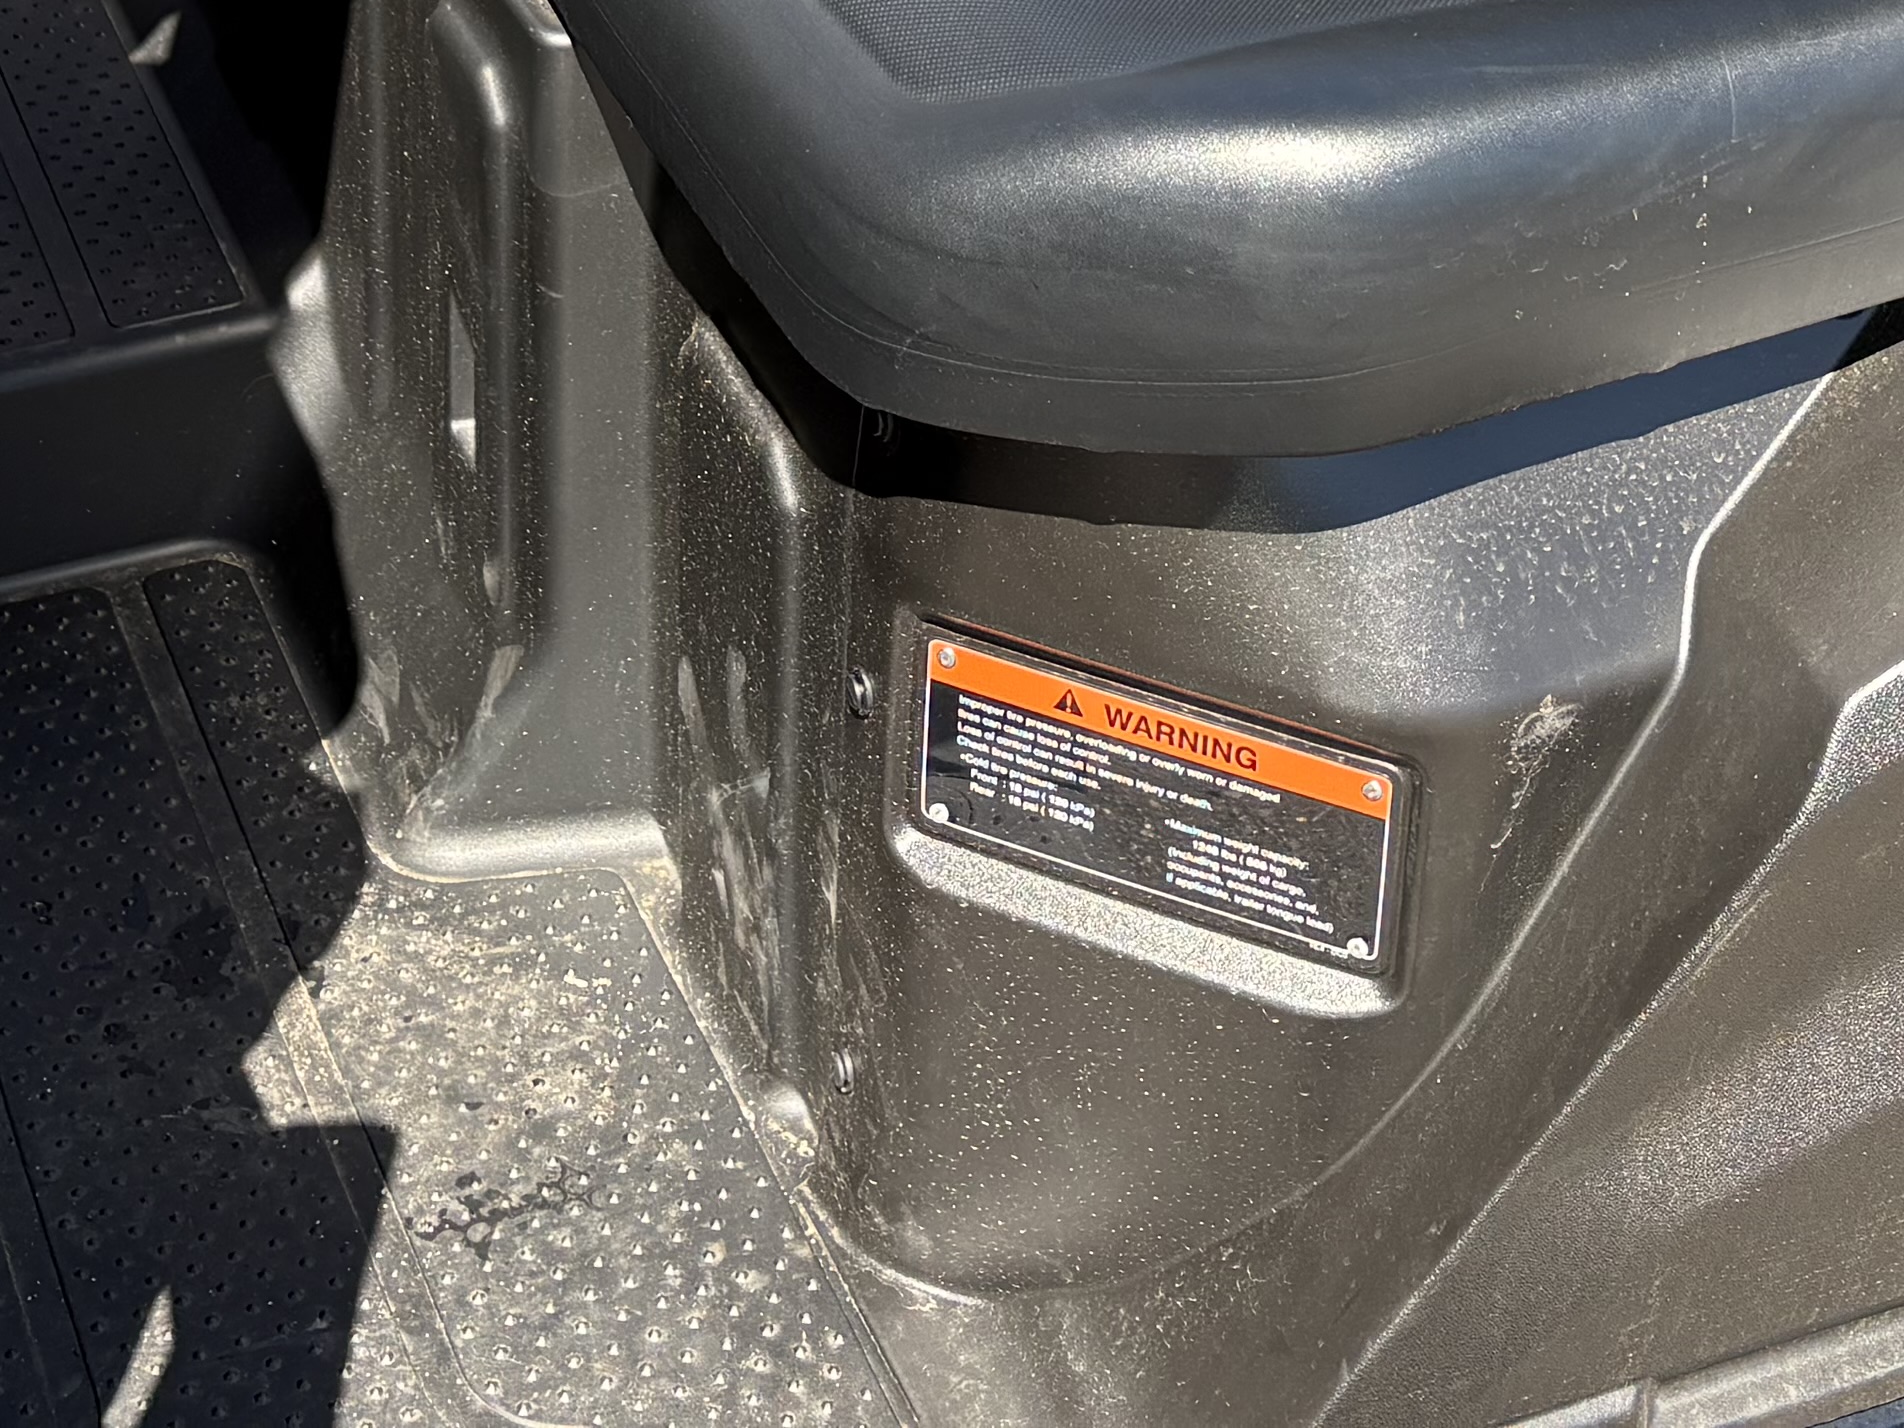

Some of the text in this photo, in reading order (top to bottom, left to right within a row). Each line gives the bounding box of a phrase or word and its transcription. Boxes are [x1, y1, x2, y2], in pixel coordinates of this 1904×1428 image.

[956, 733, 1101, 790] Check tires before each use.
[957, 707, 1112, 766] tires can cause loss of control.
[958, 693, 1281, 807] Improper tire pressure, overloading or overly worn or damaged
[1103, 702, 1259, 774] WARNING
[957, 720, 1213, 812] Loss of control can result in severe injury or death.
[990, 760, 1008, 776] tire
[1008, 767, 1058, 794] pressure:
[969, 781, 995, 799] Rear
[1022, 798, 1039, 815] psi
[1068, 813, 1095, 833] kPa)
[970, 768, 998, 786] Front
[1022, 785, 1040, 801] psi
[1069, 800, 1096, 819] kPa)
[1167, 844, 1220, 873] (including
[1221, 862, 1257, 885] weight
[1258, 873, 1271, 886] of
[1220, 847, 1237, 862] lbs
[1269, 863, 1287, 880] kg)
[1223, 834, 1259, 858] weight
[1260, 846, 1310, 873] capacity:
[1174, 874, 1232, 903] applicable,
[1233, 893, 1264, 912] trailer
[1265, 904, 1305, 927] tongue
[1306, 915, 1334, 936] load)
